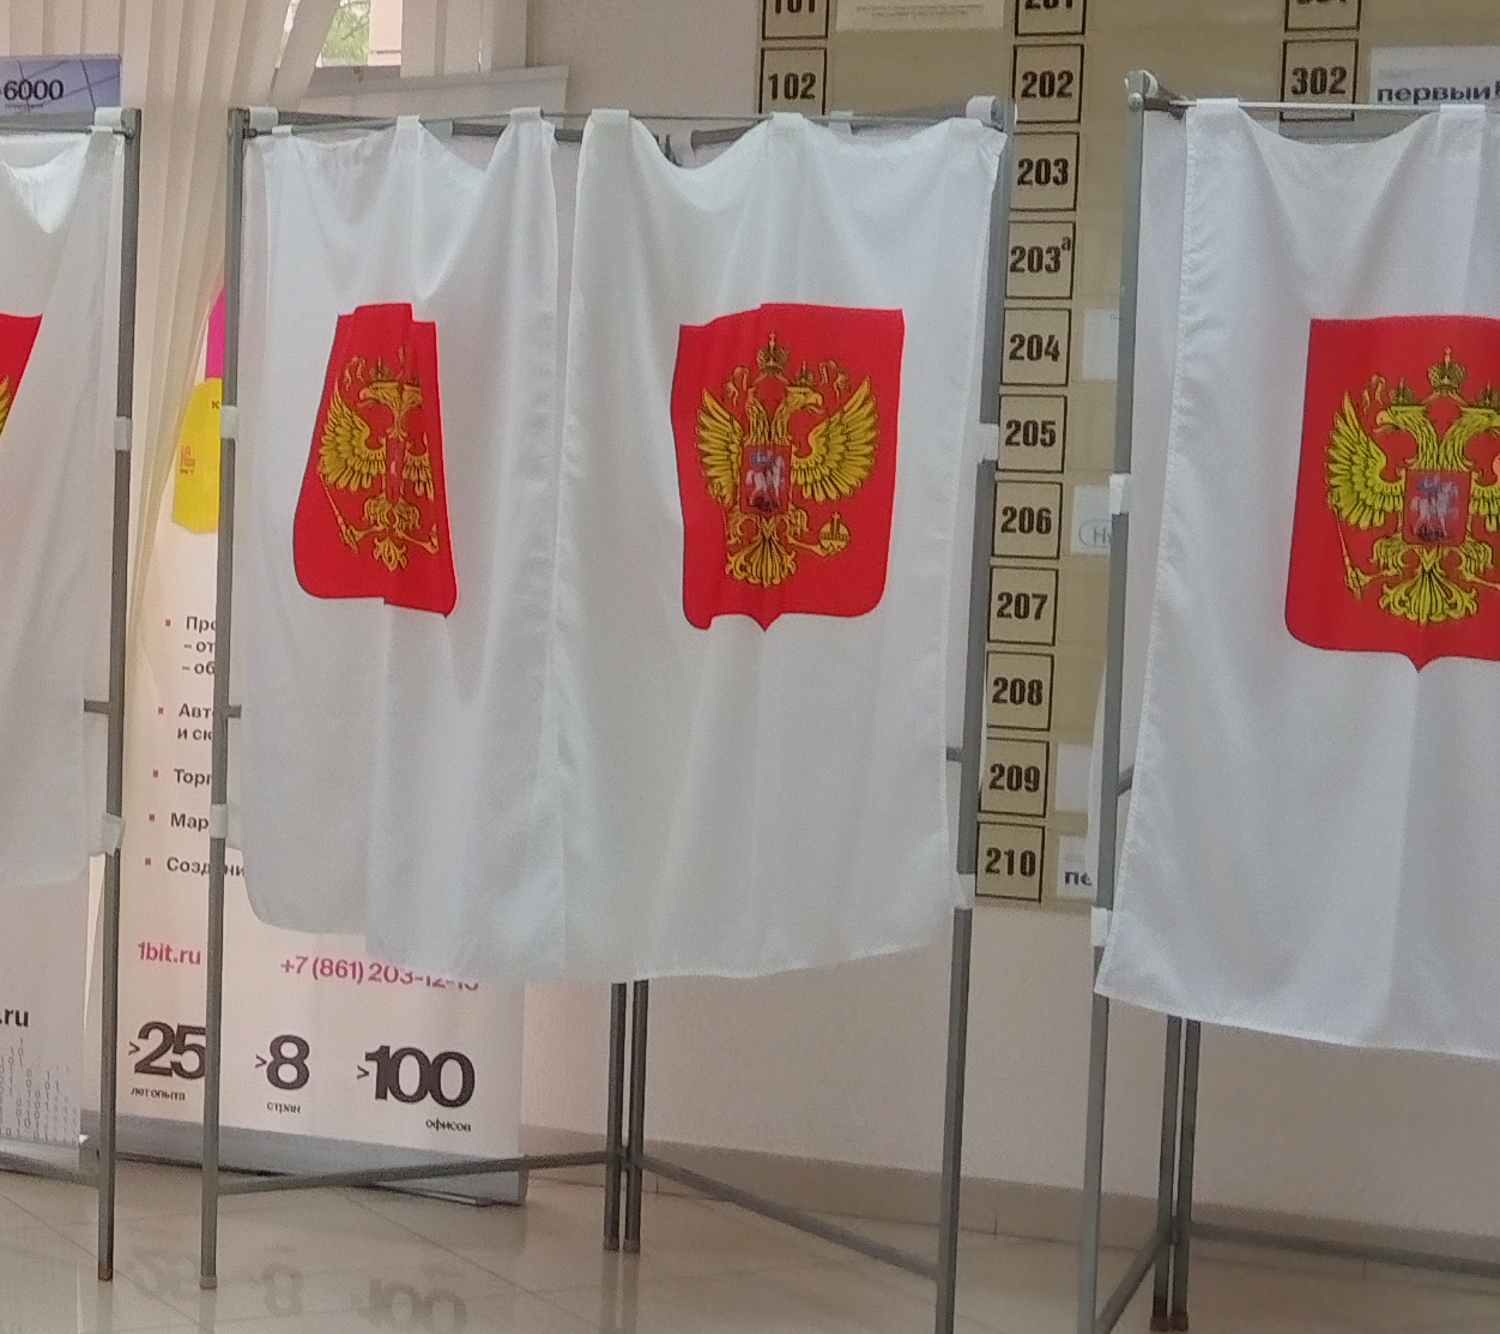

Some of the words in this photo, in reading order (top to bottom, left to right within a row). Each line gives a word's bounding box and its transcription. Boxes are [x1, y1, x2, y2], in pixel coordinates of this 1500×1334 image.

[768, 72, 816, 101] 102
[1021, 70, 1074, 99] 202
[1291, 65, 1347, 95] 302
[1017, 157, 1069, 186] 203
[1009, 333, 1061, 362] 204
[1005, 419, 1057, 447] 205
[1001, 505, 1052, 534] 206
[996, 592, 1048, 620] 207
[991, 676, 1043, 706] 208
[989, 763, 1040, 792] 209
[985, 847, 1036, 877] 210
[137, 941, 202, 965] 1bit.ru
[280, 955, 308, 974] +7
[312, 956, 364, 985] (861)
